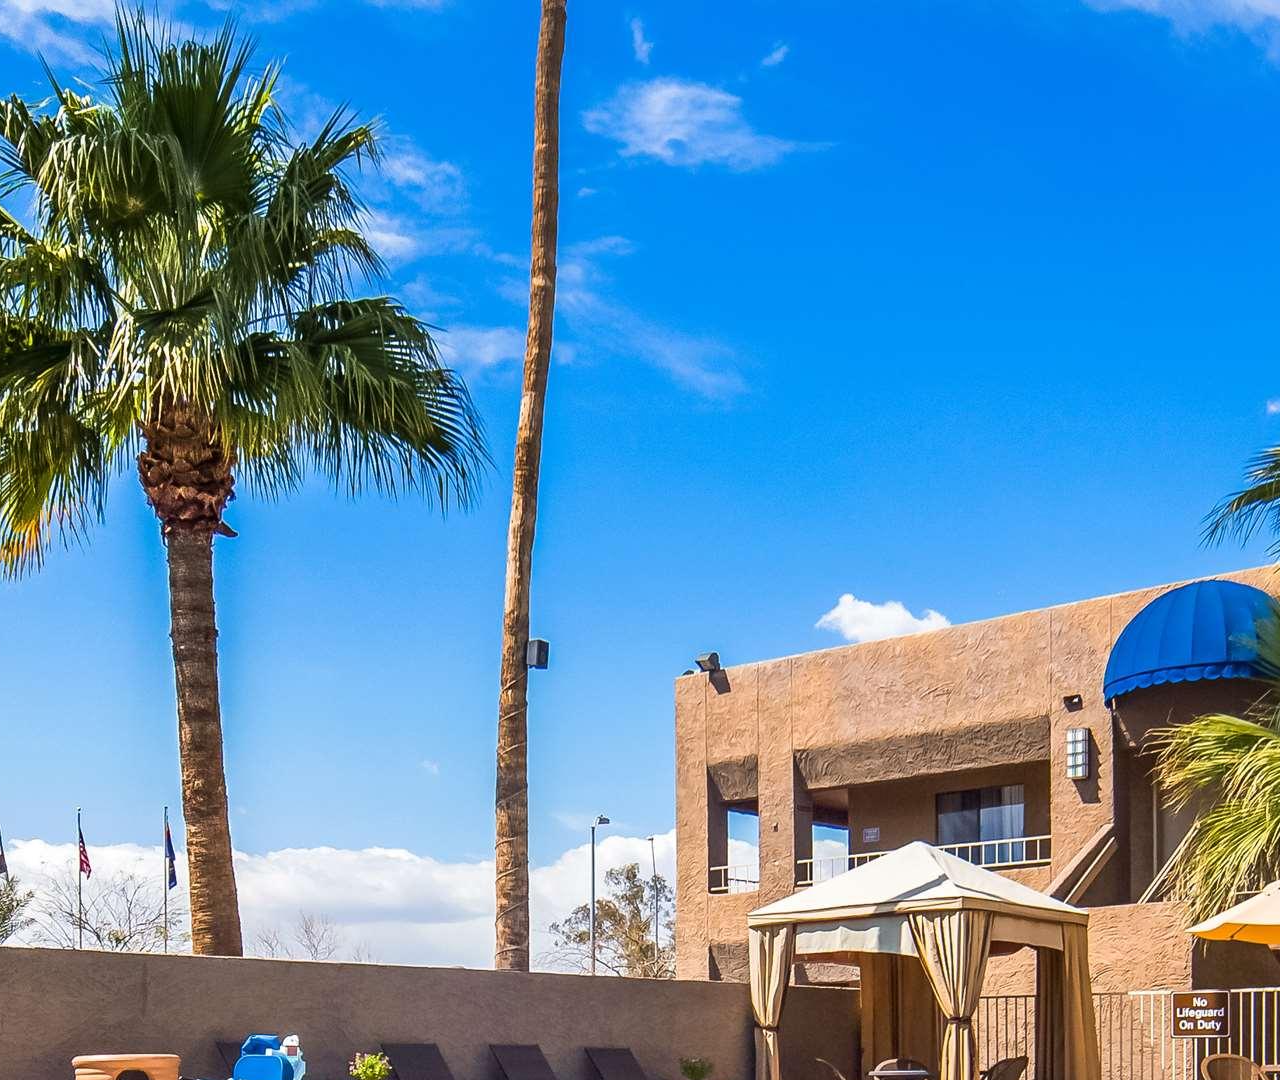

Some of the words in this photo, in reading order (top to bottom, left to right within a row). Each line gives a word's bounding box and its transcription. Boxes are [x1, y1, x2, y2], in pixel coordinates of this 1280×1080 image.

[1192, 997, 1208, 1007] No
[1176, 1007, 1225, 1019] Lifeguard
[1179, 1020, 1194, 1030] On
[1197, 1020, 1221, 1031] Duty
